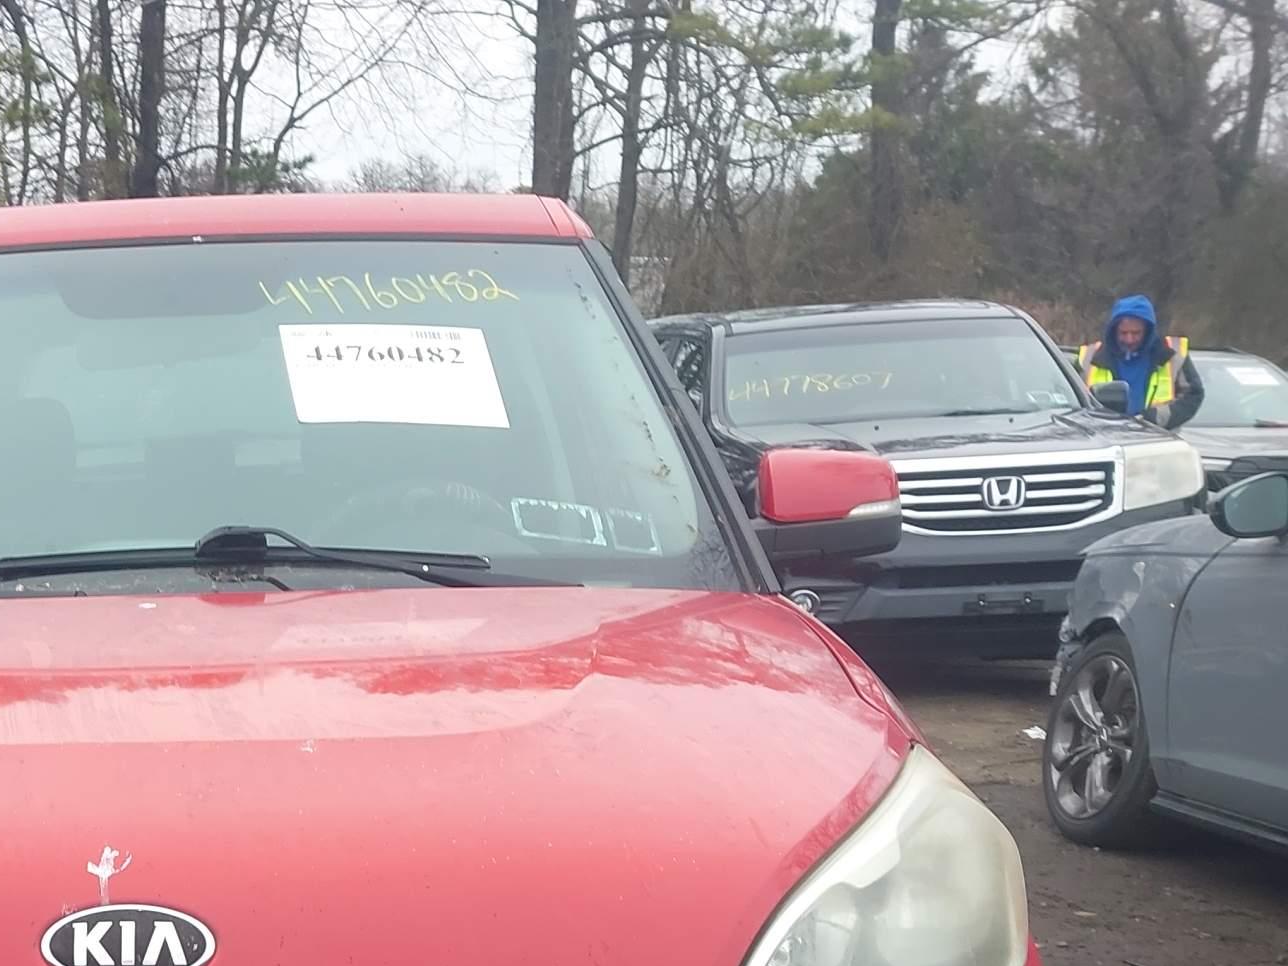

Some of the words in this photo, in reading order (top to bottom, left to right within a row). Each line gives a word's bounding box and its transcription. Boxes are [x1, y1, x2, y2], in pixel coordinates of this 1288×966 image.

[258, 268, 521, 314] 44760482
[305, 344, 465, 365] 44760482
[71, 920, 189, 966] KIA
